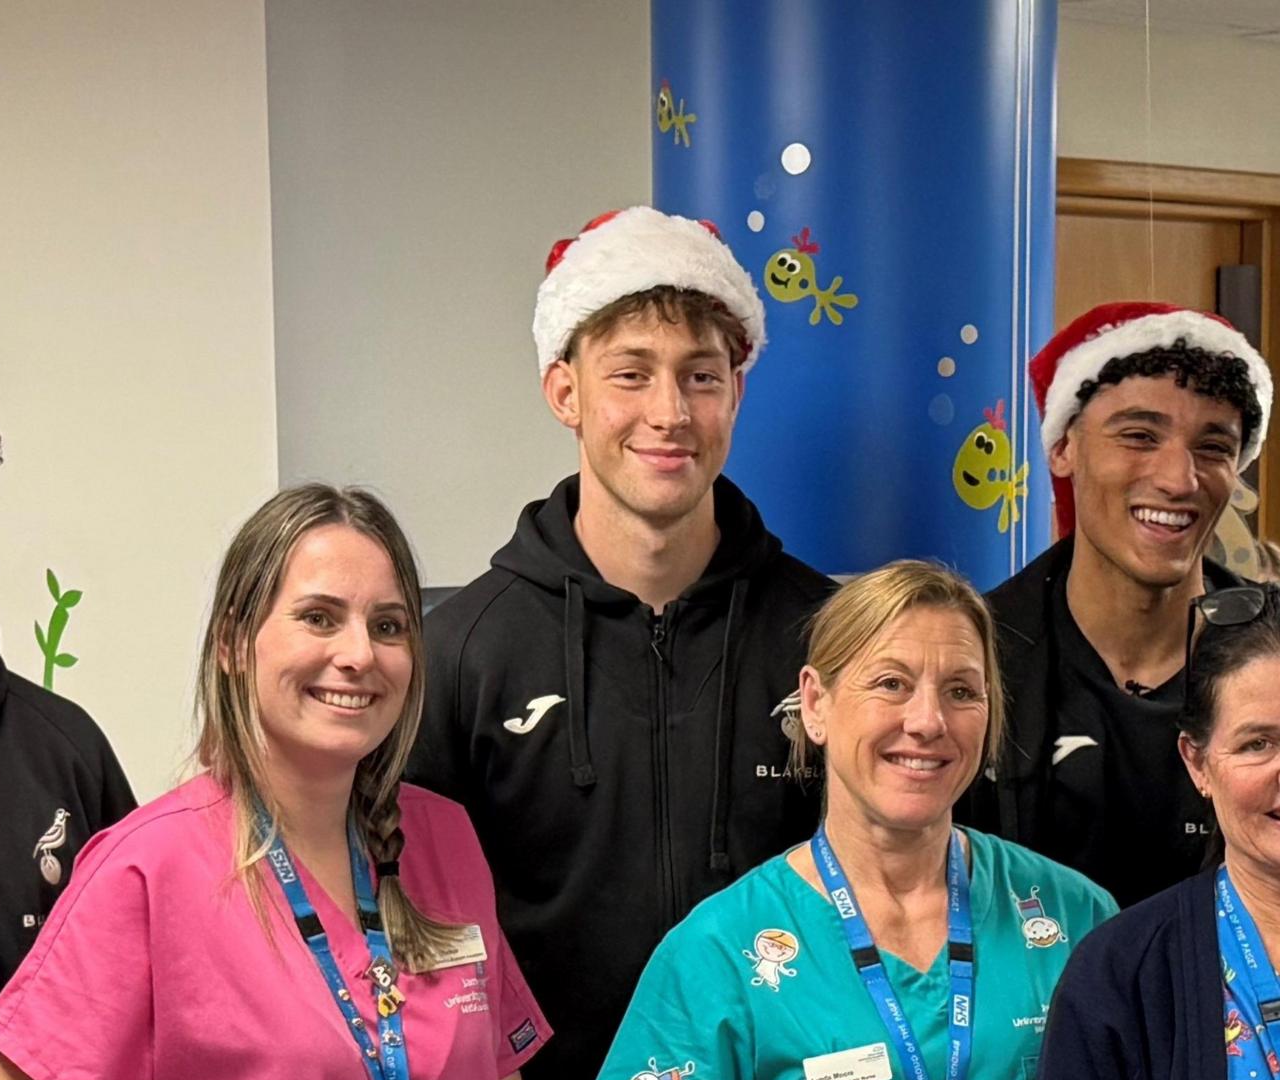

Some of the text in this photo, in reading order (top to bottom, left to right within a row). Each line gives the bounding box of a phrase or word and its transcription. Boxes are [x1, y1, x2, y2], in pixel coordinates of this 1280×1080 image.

[270, 849, 296, 883] NHS
[833, 889, 856, 918] NHS
[955, 995, 969, 1026] NHS
